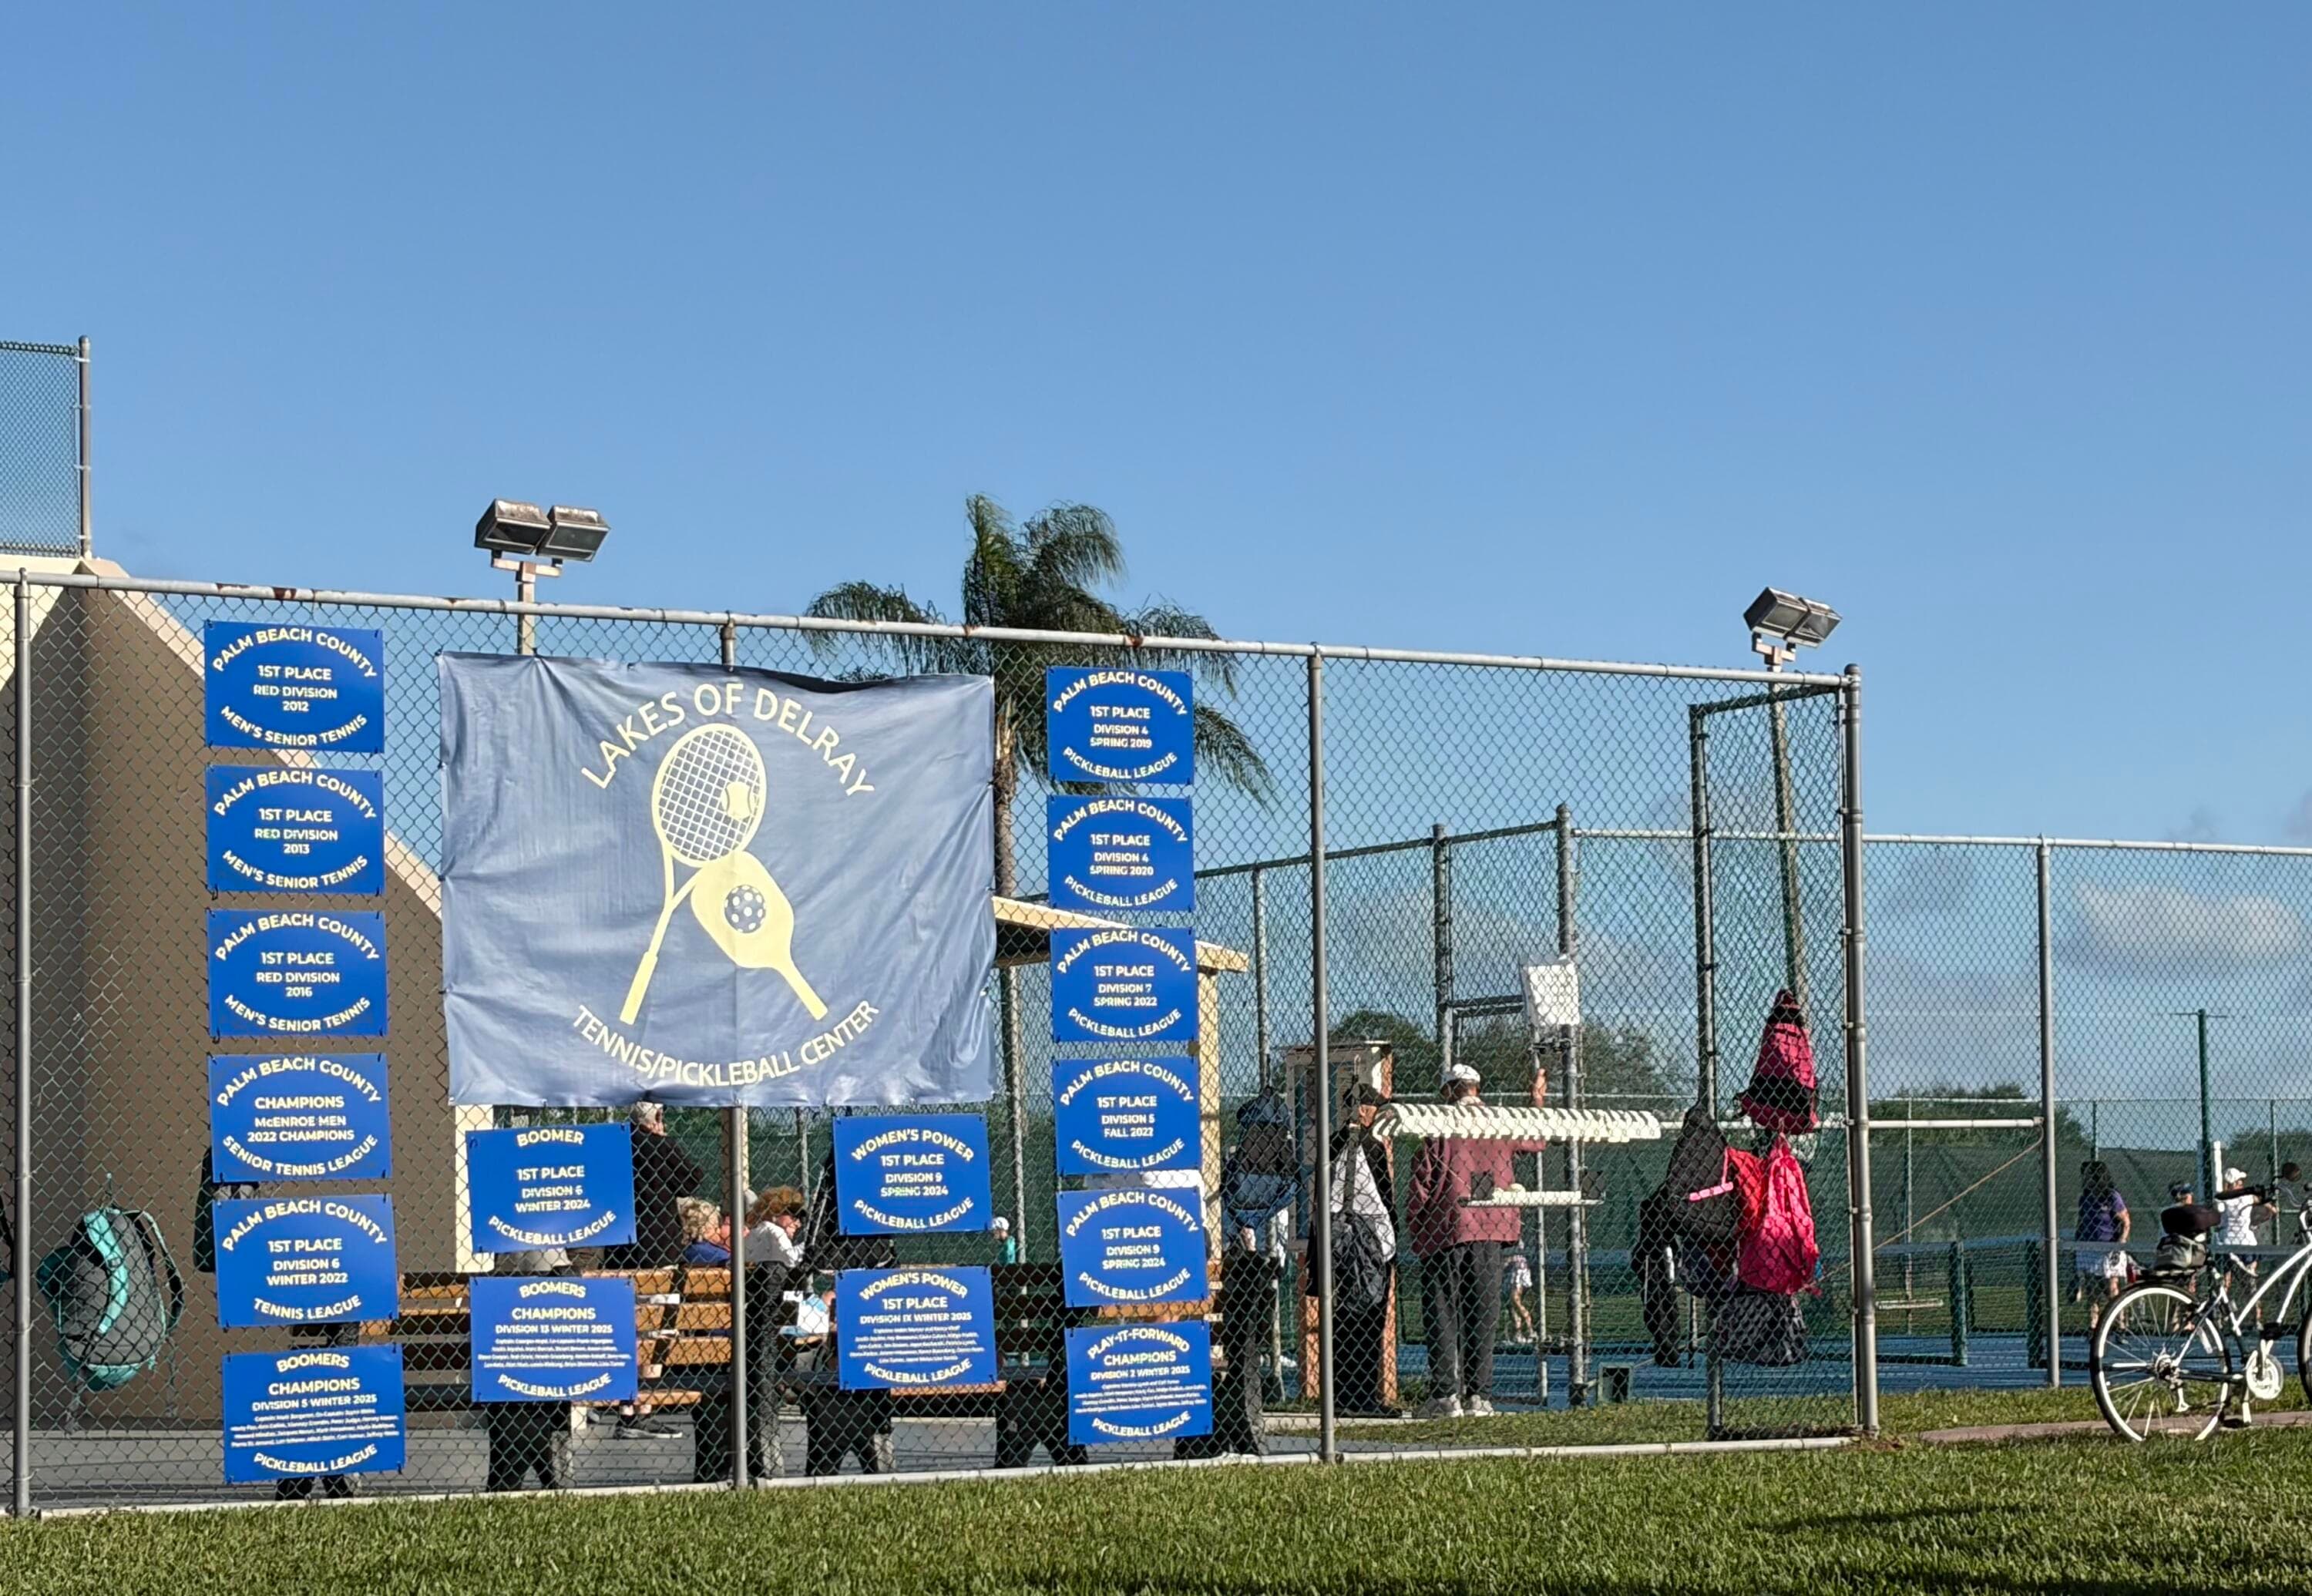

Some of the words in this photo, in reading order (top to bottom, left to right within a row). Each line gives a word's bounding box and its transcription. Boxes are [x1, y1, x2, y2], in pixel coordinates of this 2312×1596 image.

[213, 635, 254, 671] PALM
[255, 627, 312, 644] BEACH
[316, 633, 377, 677] COUNTY
[257, 665, 281, 677] 1ST
[284, 667, 331, 680] PLACE
[254, 684, 280, 696] RED
[282, 686, 338, 698] DIVISION
[1054, 678, 1087, 712] PALM
[1088, 671, 1135, 687] BEACH
[1138, 675, 1187, 714] COUNTY
[283, 701, 309, 712] 2012
[1090, 706, 1110, 717] 1ST
[1112, 707, 1150, 719] PLACE
[221, 706, 262, 738] MEN'S
[264, 731, 318, 746] SENIOR
[319, 714, 367, 743] TENNIS
[1094, 724, 1140, 735] DIVISION
[1141, 726, 1148, 734] 4
[582, 691, 686, 789] LAKES
[693, 682, 744, 717] OF
[754, 687, 874, 796] DELRAY
[1090, 737, 1128, 748] SPRING
[1130, 738, 1152, 748] 2019
[1064, 747, 1132, 779] PICKLEBALL
[1134, 753, 1177, 778] LEAGUE
[214, 778, 255, 815] PALM
[257, 770, 313, 787] BEACH
[316, 774, 376, 818] COUNTY
[259, 808, 283, 821] 1ST
[285, 809, 332, 822] PLACE
[1054, 807, 1087, 841] PALM
[1088, 799, 1134, 815] BEACH
[1138, 802, 1188, 842] COUNTY
[254, 828, 281, 839] RED
[283, 828, 338, 841] DIVISION
[1090, 834, 1111, 845] 1ST
[1112, 834, 1150, 846] PLACE
[284, 843, 310, 854] 2013
[1094, 852, 1140, 862] DIVISION
[1141, 853, 1148, 862] 4
[223, 851, 264, 882] MEN'S
[266, 874, 318, 889] SENIOR
[321, 855, 368, 885] TENNIS
[1090, 865, 1128, 875] SPRING
[1129, 865, 1154, 876] 2020
[1065, 875, 1133, 907] PICKLEBALL
[1134, 879, 1178, 906] LEAGUE
[215, 922, 256, 960] PALM
[257, 913, 314, 931] BEACH
[318, 917, 379, 959] COUNTY
[261, 952, 284, 964] 1ST
[287, 953, 334, 965] PLACE
[1057, 939, 1090, 973] PALM
[1091, 929, 1138, 946] BEACH
[1141, 932, 1191, 971] COUNTY
[256, 972, 283, 983] RED
[285, 972, 340, 983] DIVISION
[1094, 966, 1114, 977] 1ST
[1115, 965, 1154, 977] PLACE
[286, 986, 313, 997] 2016
[1098, 983, 1144, 993] DIVISION
[1145, 983, 1152, 992] 7
[1094, 996, 1132, 1006] SPRING
[1134, 996, 1158, 1006] 2022
[225, 995, 266, 1026] MEN'S
[268, 1017, 321, 1032] SENIOR
[323, 997, 370, 1028] TENNIS
[1068, 1008, 1136, 1038] PICKLEBALL
[1138, 1009, 1181, 1037] LEAGUE
[573, 1004, 800, 1087] TENNIS/PICKLEBALL
[800, 1000, 880, 1065] CENTER
[217, 1067, 257, 1106] PALM
[258, 1057, 315, 1076] BEACH
[319, 1060, 381, 1102] COUNTY
[1060, 1070, 1094, 1105] PALM
[1094, 1060, 1140, 1077] BEACH
[1143, 1063, 1194, 1100] COUNTY
[254, 1096, 344, 1110] CHAMPIONS
[1097, 1097, 1117, 1108] 1ST
[1118, 1096, 1157, 1107] PLACE
[254, 1116, 316, 1127] McENROE
[318, 1115, 347, 1127] MEN
[1101, 1114, 1147, 1124] DIVISION
[1148, 1114, 1155, 1124] 5
[247, 1131, 277, 1142] 2022
[279, 1130, 355, 1142] CHAMPIONS
[516, 1128, 584, 1147] BOOMER
[1104, 1127, 1129, 1137] FALL
[1130, 1127, 1154, 1137] 2022
[852, 1128, 919, 1161] WOMEN'S
[922, 1130, 974, 1161] POWER
[223, 1136, 273, 1171] SENIOR
[275, 1163, 326, 1176] TENNIS
[328, 1134, 378, 1171] LEAGUE
[881, 1154, 901, 1167] 1ST
[903, 1154, 944, 1166] PLACE
[1072, 1140, 1140, 1169] PICKLEBALL
[1141, 1138, 1184, 1168] LEAGUE
[517, 1168, 539, 1181] 1ST
[541, 1165, 584, 1179] PLACE
[880, 1186, 921, 1197] SPRING
[922, 1185, 949, 1196] 2024
[515, 1200, 561, 1213] WINTER
[563, 1199, 591, 1211] 2024
[854, 1200, 926, 1229] PICKLEBALL
[929, 1197, 973, 1227] LEAGUE
[1066, 1201, 1099, 1237] PALM
[1099, 1191, 1145, 1209] BEACH
[1148, 1193, 1198, 1231] COUNTY
[222, 1211, 263, 1251] PALM
[264, 1199, 321, 1219] BEACH
[324, 1202, 388, 1243] COUNTY
[489, 1216, 567, 1246] PICKLEBALL
[568, 1211, 616, 1243] LEAGUE
[1101, 1228, 1121, 1240] 1ST
[1122, 1225, 1161, 1238] PLACE
[267, 1240, 292, 1253] 1ST
[294, 1238, 342, 1252] PLACE
[273, 1258, 329, 1272] DIVISION
[331, 1258, 340, 1268] 6
[1102, 1258, 1141, 1270] SPRING
[1141, 1257, 1166, 1268] 2024
[267, 1273, 318, 1286] WINTER
[319, 1272, 348, 1284] 2022
[859, 1272, 920, 1300] WOMEN'S
[921, 1272, 968, 1299] POWER
[1079, 1272, 1148, 1300] PICKLEBALL
[1149, 1268, 1191, 1299] LEAGUE
[519, 1281, 586, 1299] BOOMERS
[254, 1298, 304, 1320] TENNIS
[307, 1295, 361, 1319] LEAGUE
[882, 1298, 903, 1310] 1ST
[906, 1296, 948, 1309] PLACE
[512, 1307, 596, 1320] CHAMPIONS
[1087, 1328, 1190, 1359] PLAY-IT-FORWARD
[277, 1352, 350, 1373] BOOMERS
[1103, 1350, 1177, 1366] CHAMPIONS
[864, 1362, 930, 1383] PICKLEBALL
[931, 1356, 972, 1382] LEAGUE
[268, 1377, 360, 1396] CHAMPIONS
[498, 1374, 566, 1397] PICKLEBALL
[568, 1373, 611, 1396] LEAGUE
[252, 1399, 299, 1411] DIVISION
[301, 1398, 308, 1408] 5
[310, 1396, 351, 1406] WINTER
[353, 1394, 377, 1404] 2025
[1092, 1417, 1152, 1437] PICKLEBALL
[1153, 1411, 1191, 1435] LEAGUE
[254, 1453, 329, 1473] PICKLEBALL
[331, 1444, 377, 1470] LEAGUE
